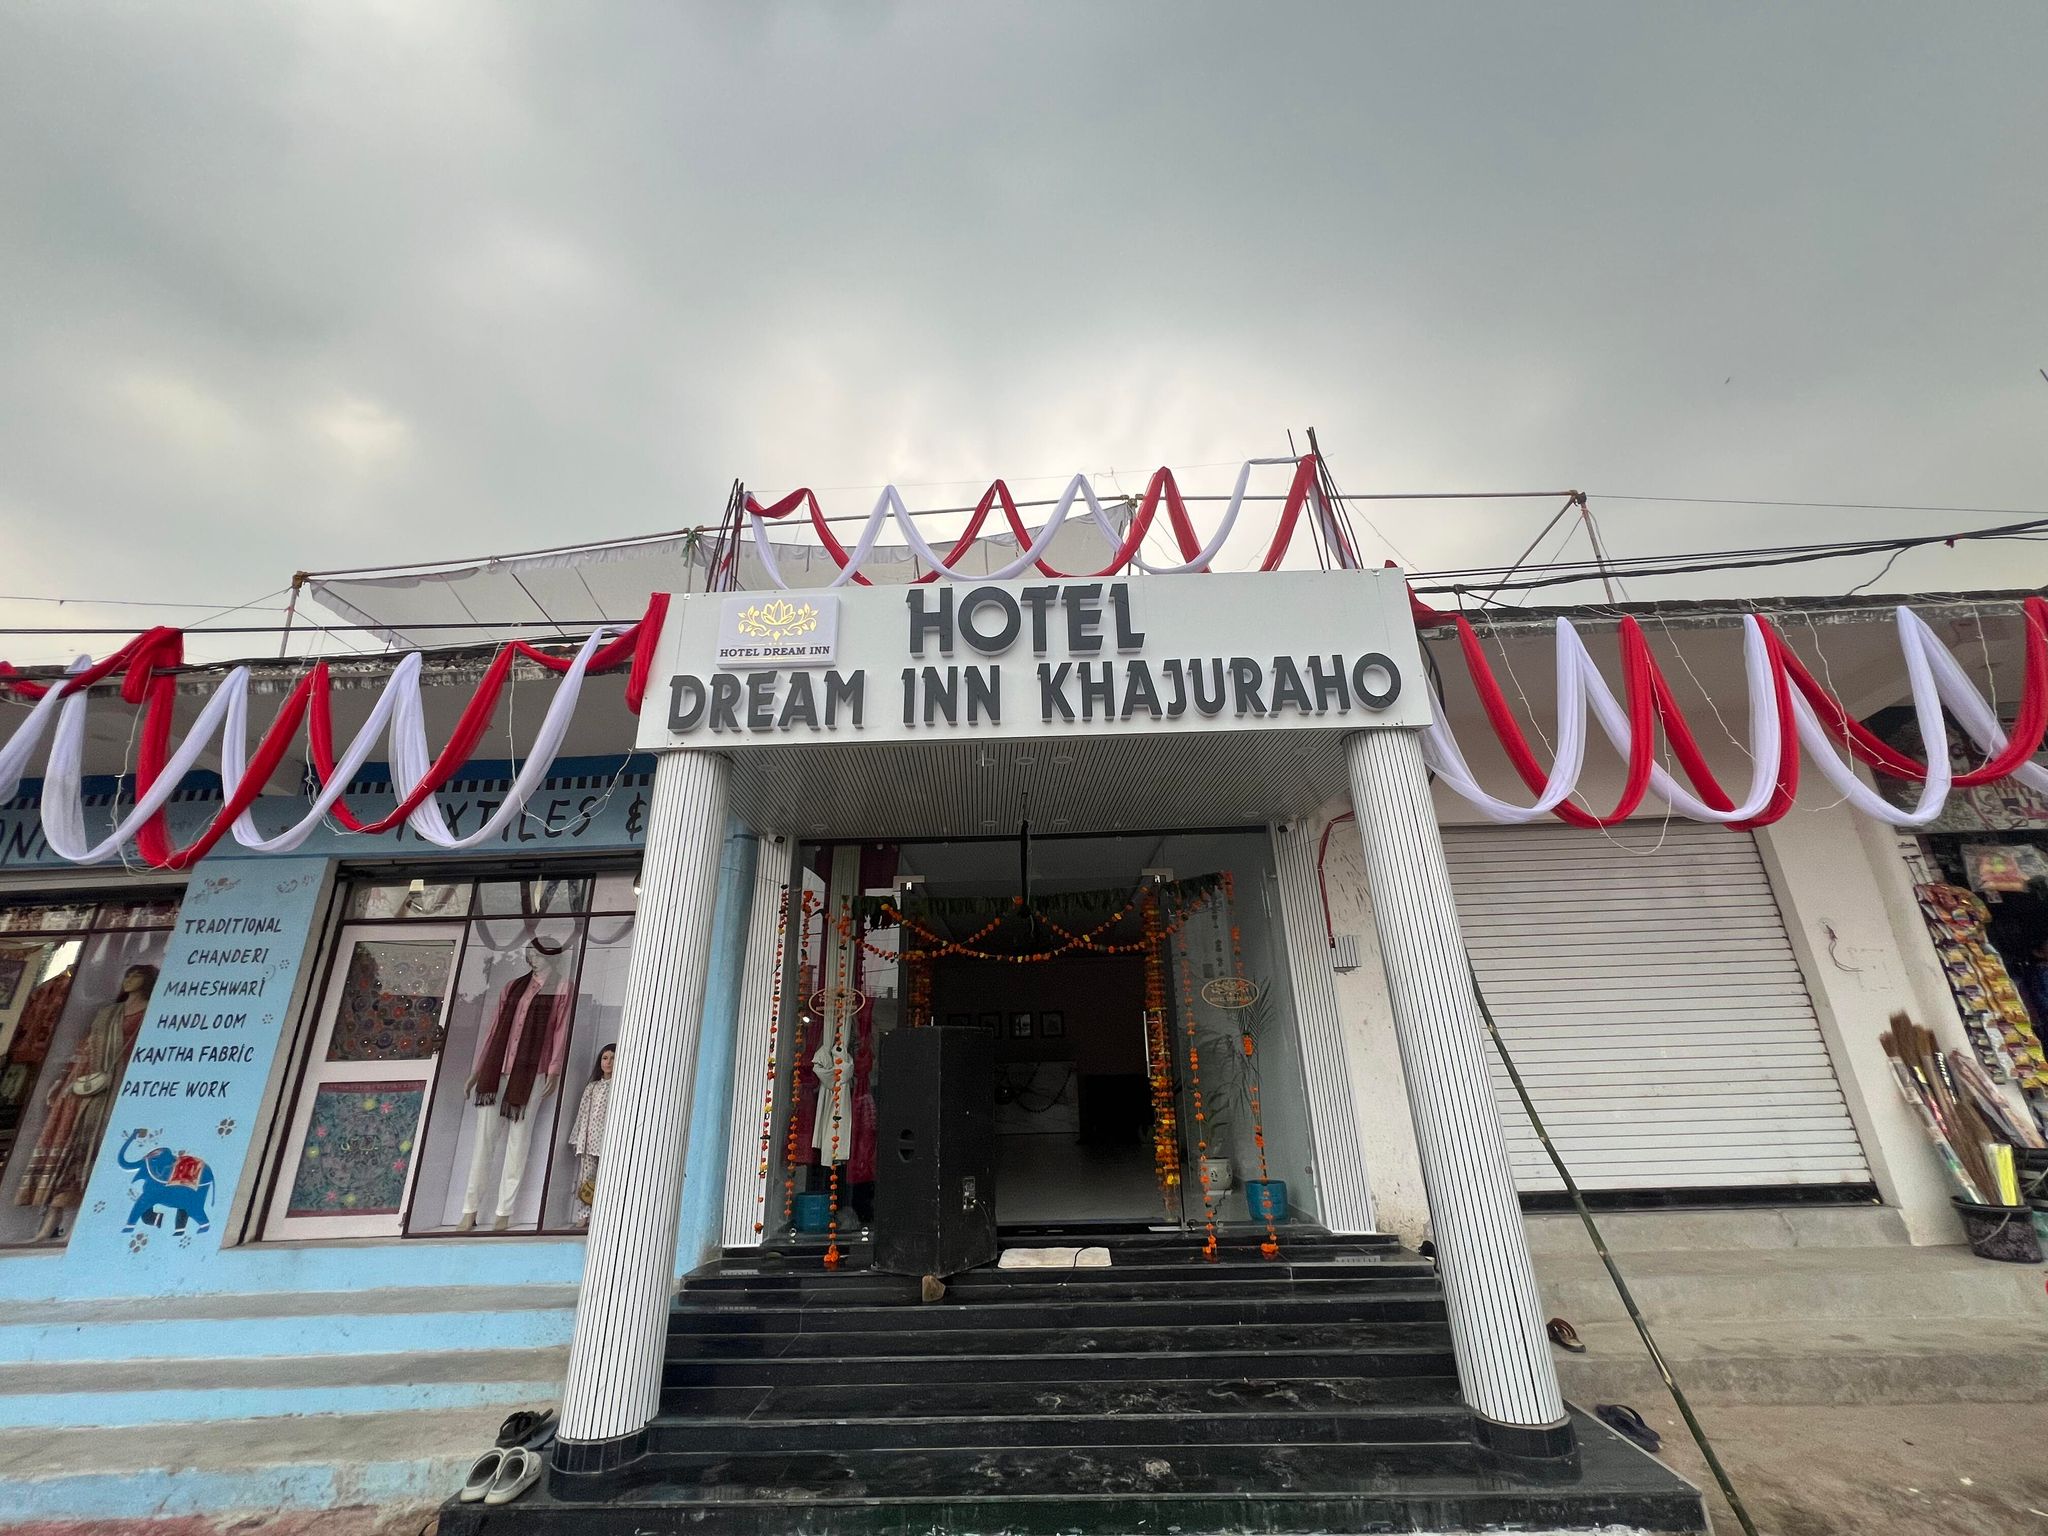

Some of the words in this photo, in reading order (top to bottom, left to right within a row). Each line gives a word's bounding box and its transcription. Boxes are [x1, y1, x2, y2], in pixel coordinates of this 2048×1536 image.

[905, 583, 1145, 657] HOTEL
[720, 648, 759, 658] HOTEL
[763, 646, 806, 656] DREAM
[810, 646, 830, 655] INN
[667, 670, 866, 733] DREAM
[901, 664, 1001, 728] INN
[1037, 652, 1402, 722] KHAJURAHO
[394, 796, 600, 842] XTLES
[185, 917, 282, 936] TRADITIONAL
[187, 948, 269, 966] CHANDERI
[163, 977, 266, 998] MAHESHWARI
[132, 1046, 193, 1065] KANTHA
[198, 1043, 254, 1063] FABRIC
[121, 1081, 180, 1098] PATCHE
[185, 1080, 231, 1098] WORK
